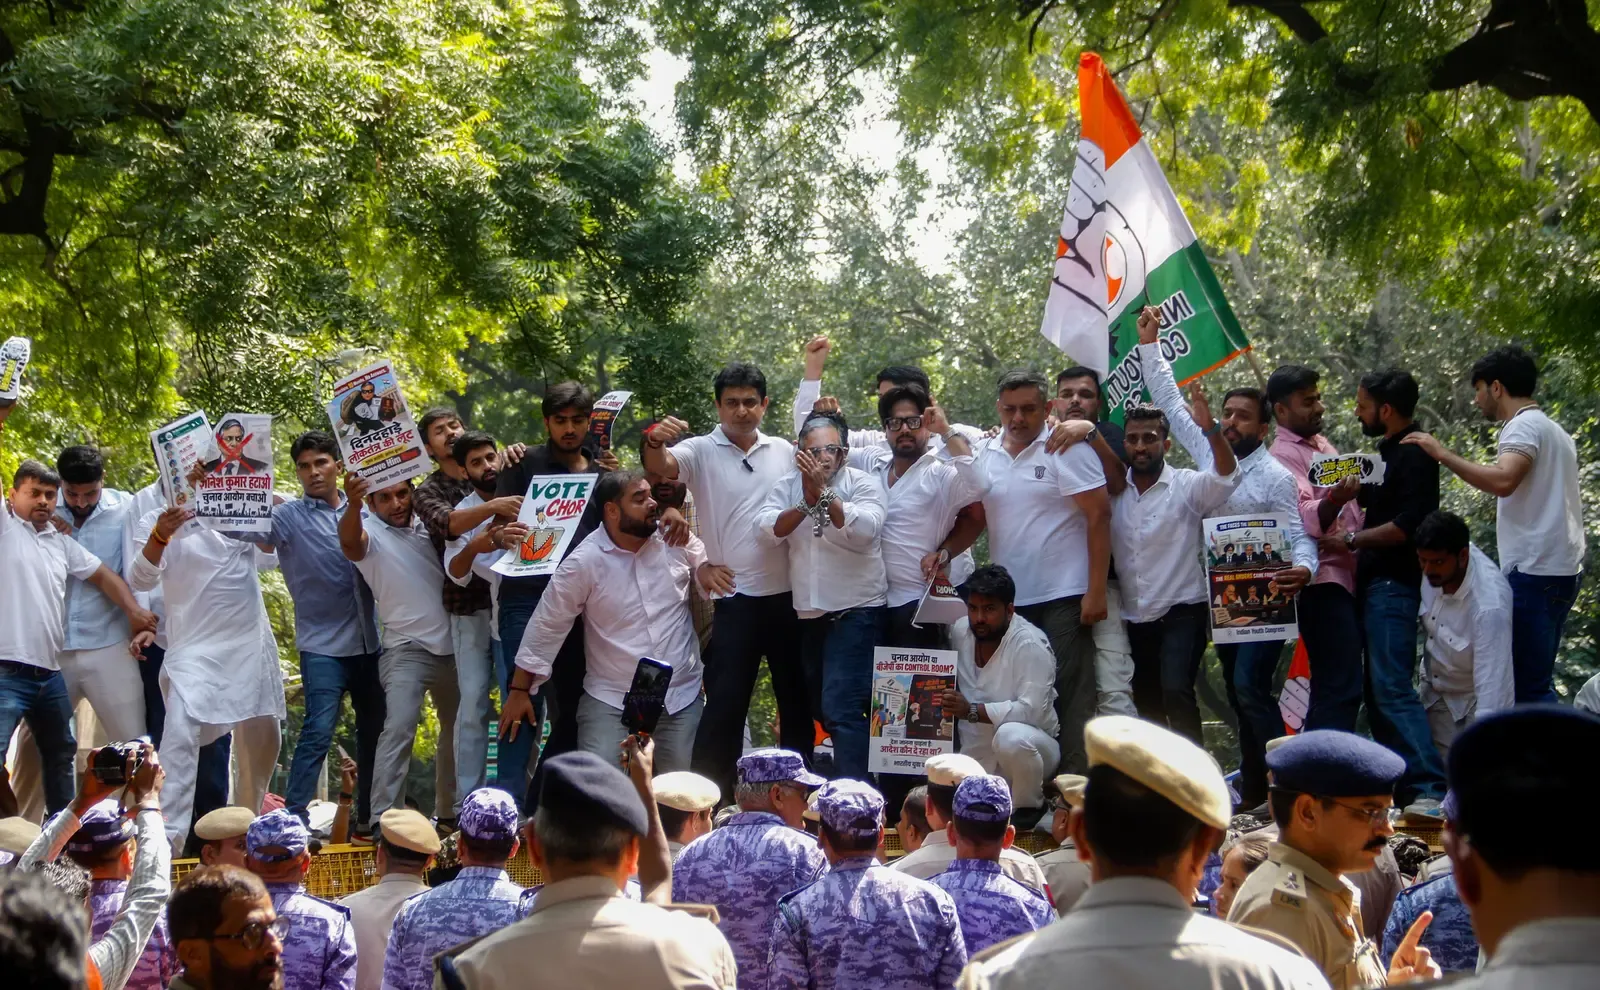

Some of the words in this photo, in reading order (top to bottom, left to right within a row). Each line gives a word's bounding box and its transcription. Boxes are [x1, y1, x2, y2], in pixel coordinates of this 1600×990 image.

[350, 421, 403, 450] दिनदहाड़े
[348, 442, 381, 464] लोकतंत्र
[383, 437, 395, 448] की
[396, 429, 414, 444] लूट
[357, 462, 386, 478] Remove
[386, 456, 401, 468] Him
[375, 476, 388, 485] Indian
[388, 471, 400, 479] Youth
[400, 464, 420, 475] Congress
[226, 475, 247, 491] कुमार
[249, 473, 271, 490] हटाओ
[531, 481, 590, 500] VOTE
[202, 492, 223, 504] चुनाव
[223, 490, 245, 502] आयोग
[246, 490, 267, 503] बचाओ
[545, 498, 587, 518] CHOR
[1265, 626, 1286, 634] Congress
[891, 653, 909, 664] चुनाव
[909, 652, 931, 664] आयोग
[876, 661, 895, 672] बीजेपी
[895, 663, 904, 671] का
[904, 663, 930, 672] CONTROL
[931, 664, 955, 674] ROOM?
[880, 743, 899, 754] आदेश
[899, 744, 913, 755] कौन
[913, 745, 919, 755] दे
[919, 748, 929, 756] रहा
[893, 759, 911, 767] भारतीय
